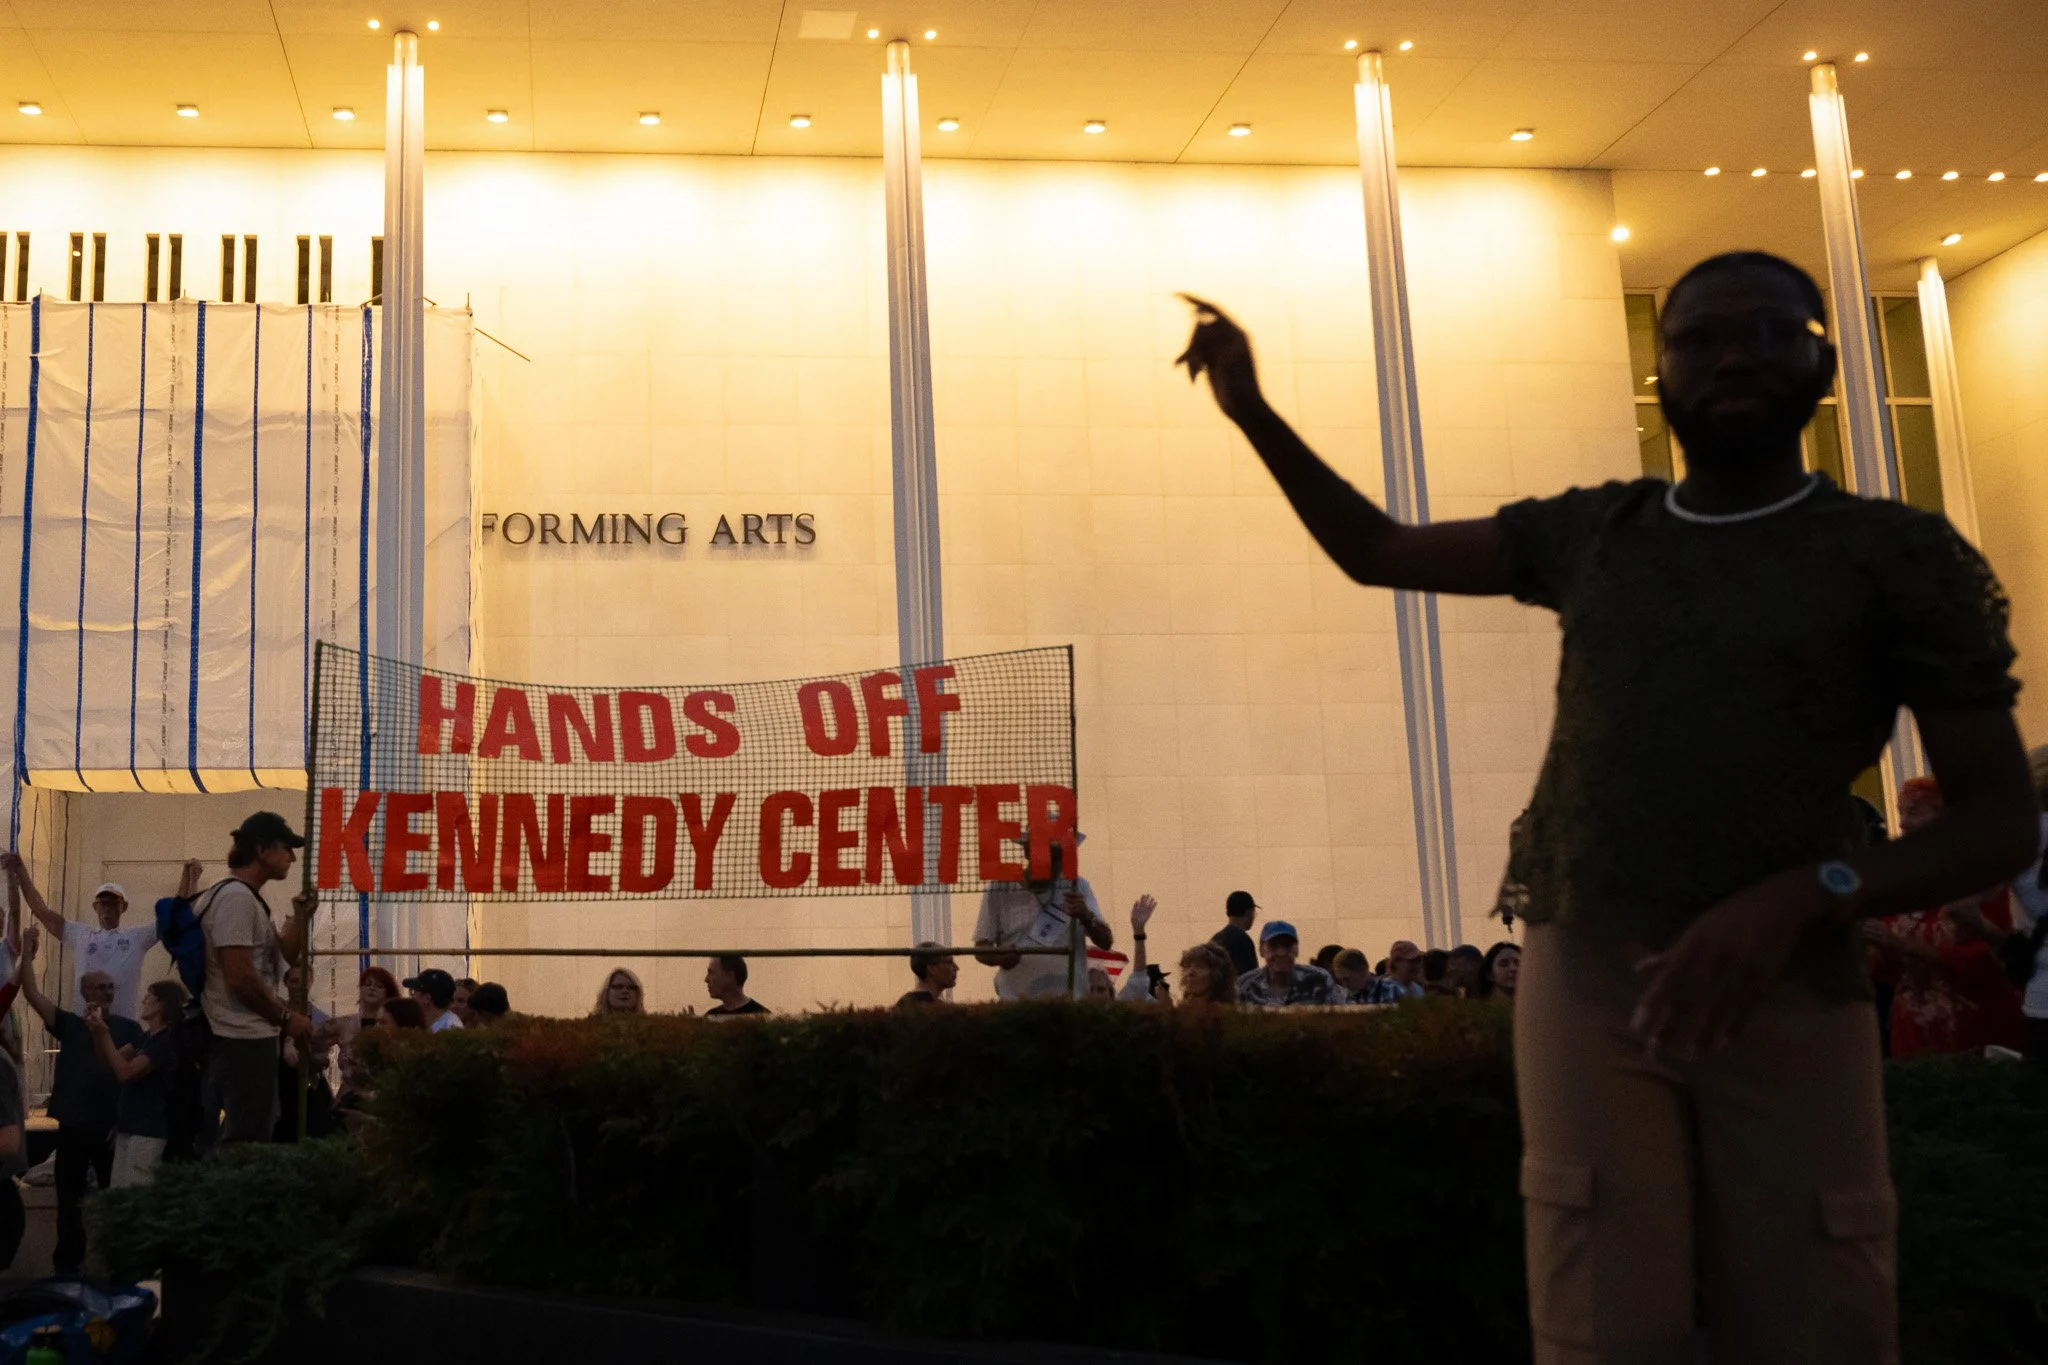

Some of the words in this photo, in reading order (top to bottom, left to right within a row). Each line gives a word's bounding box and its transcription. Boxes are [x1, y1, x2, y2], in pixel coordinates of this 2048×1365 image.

[709, 513, 817, 545] ARTS
[418, 674, 741, 765] HANDS
[798, 665, 961, 758] OFF
[316, 786, 738, 895] KENNEDY
[758, 783, 1079, 890] CENTER
